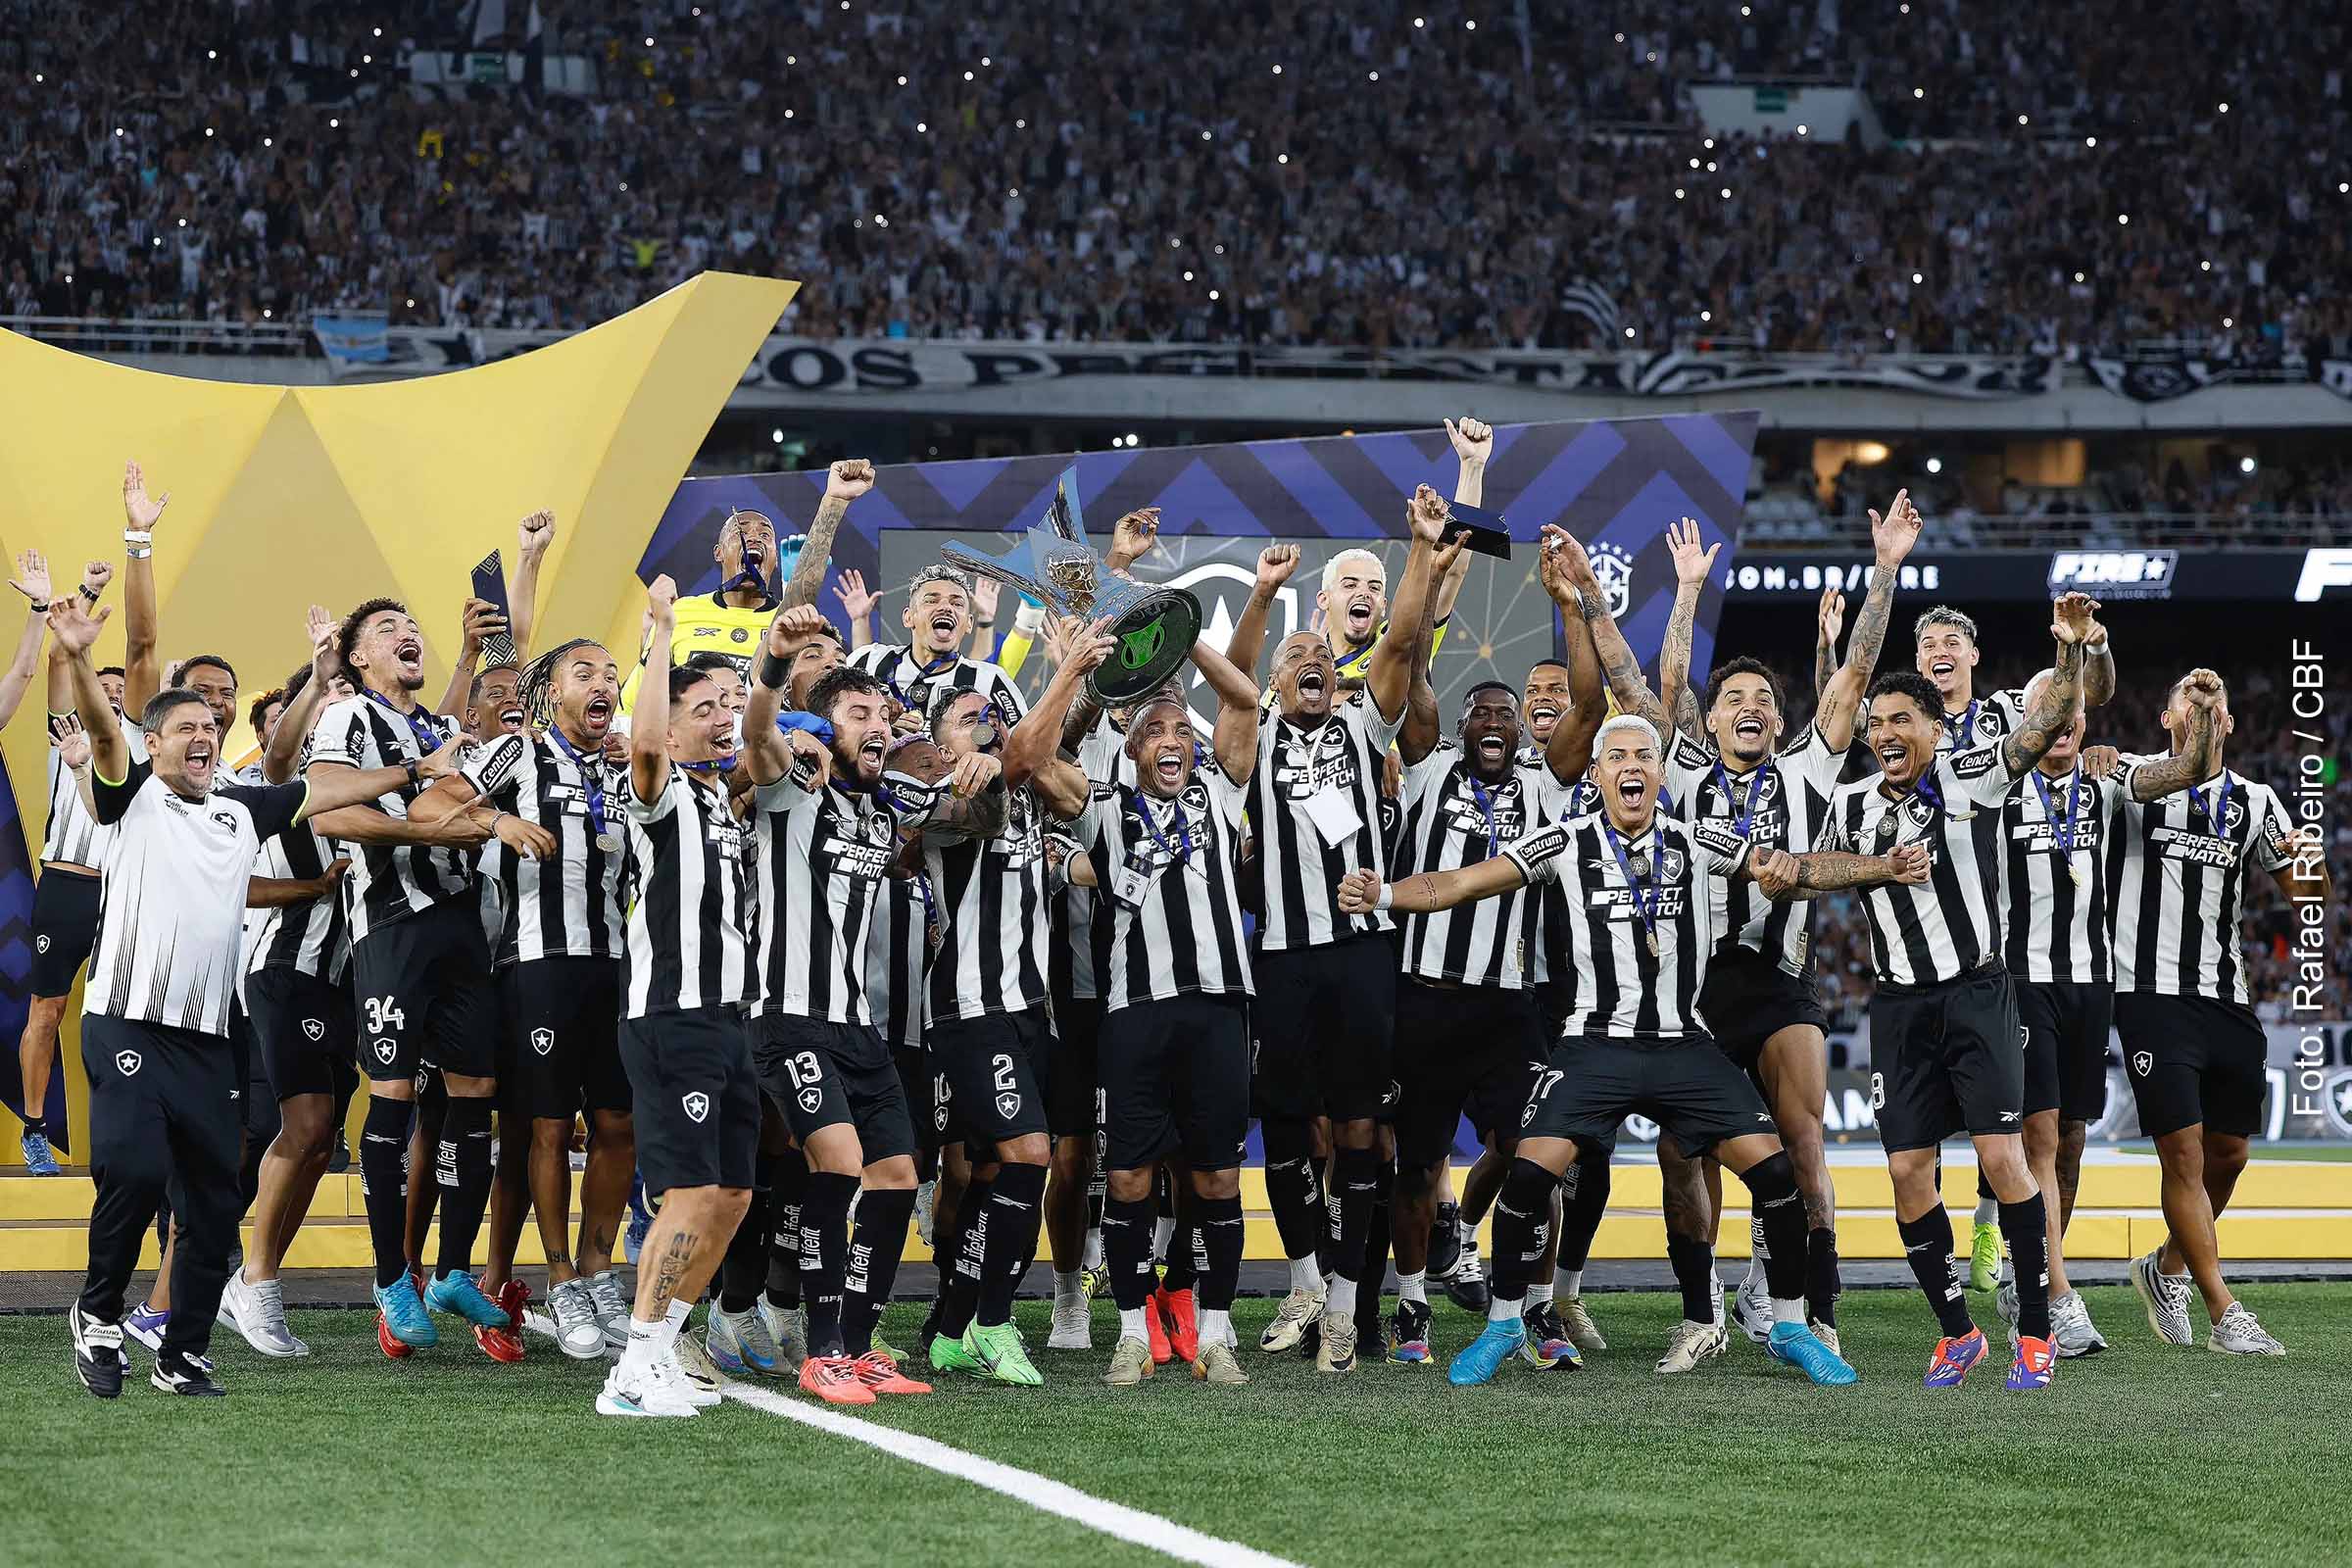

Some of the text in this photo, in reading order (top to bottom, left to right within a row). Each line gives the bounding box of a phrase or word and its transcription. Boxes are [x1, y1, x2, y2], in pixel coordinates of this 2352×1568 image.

[482, 739, 521, 784] Centrum
[1290, 755, 1348, 783] PERFECT
[1459, 799, 1520, 825] PERECT
[841, 843, 892, 864] PERFEC
[1518, 834, 1563, 858] Centrum
[2048, 833, 2097, 850] MTCH
[1607, 886, 1684, 904] PEFCT
[1629, 901, 1684, 917] MTCH
[365, 996, 405, 1035] 34
[784, 1051, 823, 1090] 13
[992, 1054, 1016, 1091] 2
